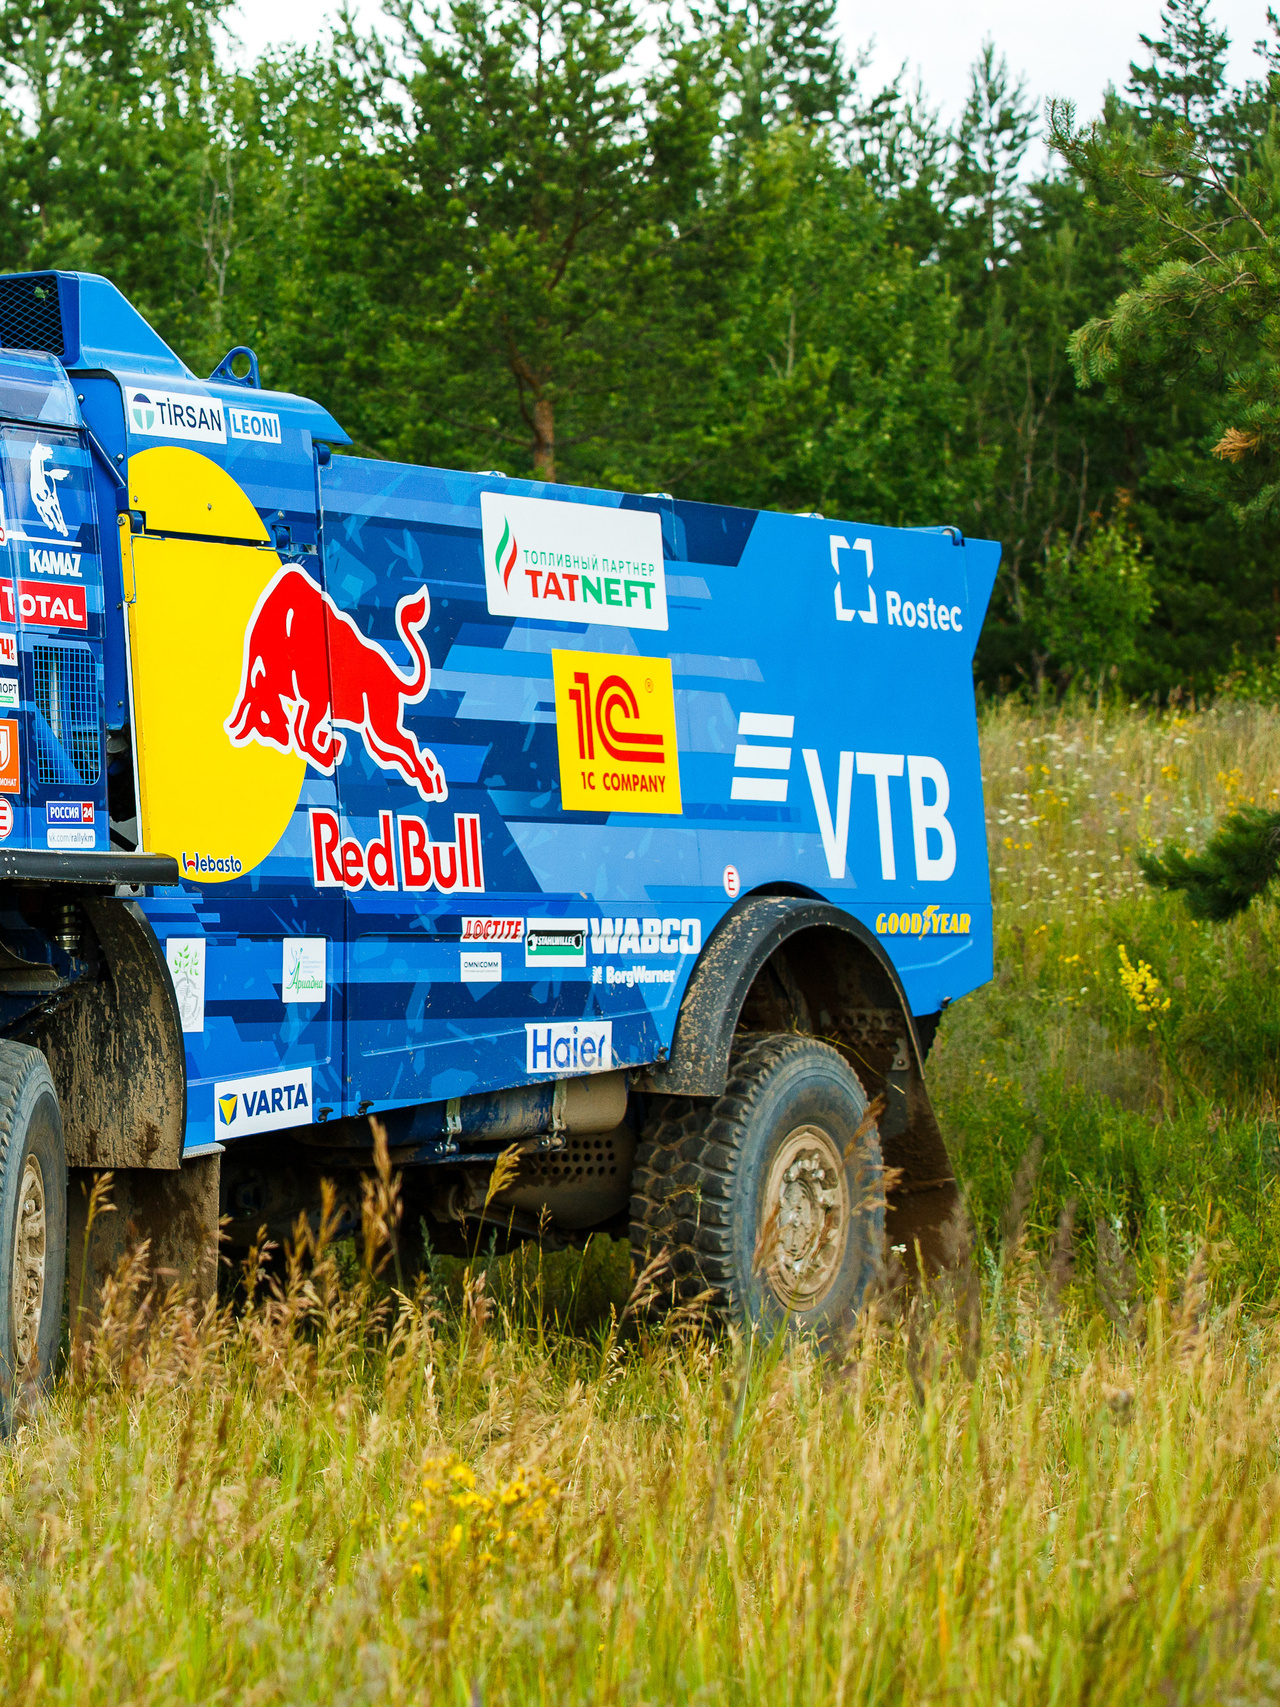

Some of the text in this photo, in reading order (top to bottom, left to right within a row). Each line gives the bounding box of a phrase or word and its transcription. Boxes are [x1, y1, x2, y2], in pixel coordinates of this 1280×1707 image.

[232, 413, 279, 438] LEONI
[29, 549, 82, 577] KAMAZ
[524, 550, 655, 577] ТОПЛИВНЫЙ ПАРТНЕР
[2, 586, 83, 622] TOTAL
[525, 570, 656, 610] TATNEFT
[886, 591, 963, 632] Rostec
[603, 773, 666, 793] COMPANY
[50, 807, 93, 819] РОССИЯ 24
[802, 749, 957, 881] VTB
[182, 852, 242, 874] Webasto
[310, 811, 483, 890] Red Bull
[463, 920, 521, 940] LOCTITE
[590, 918, 702, 954] WABCO
[286, 961, 324, 994] Ариадна
[606, 966, 676, 987] BorgWarner
[533, 1025, 605, 1069] Haier
[242, 1083, 308, 1117] VARTA
